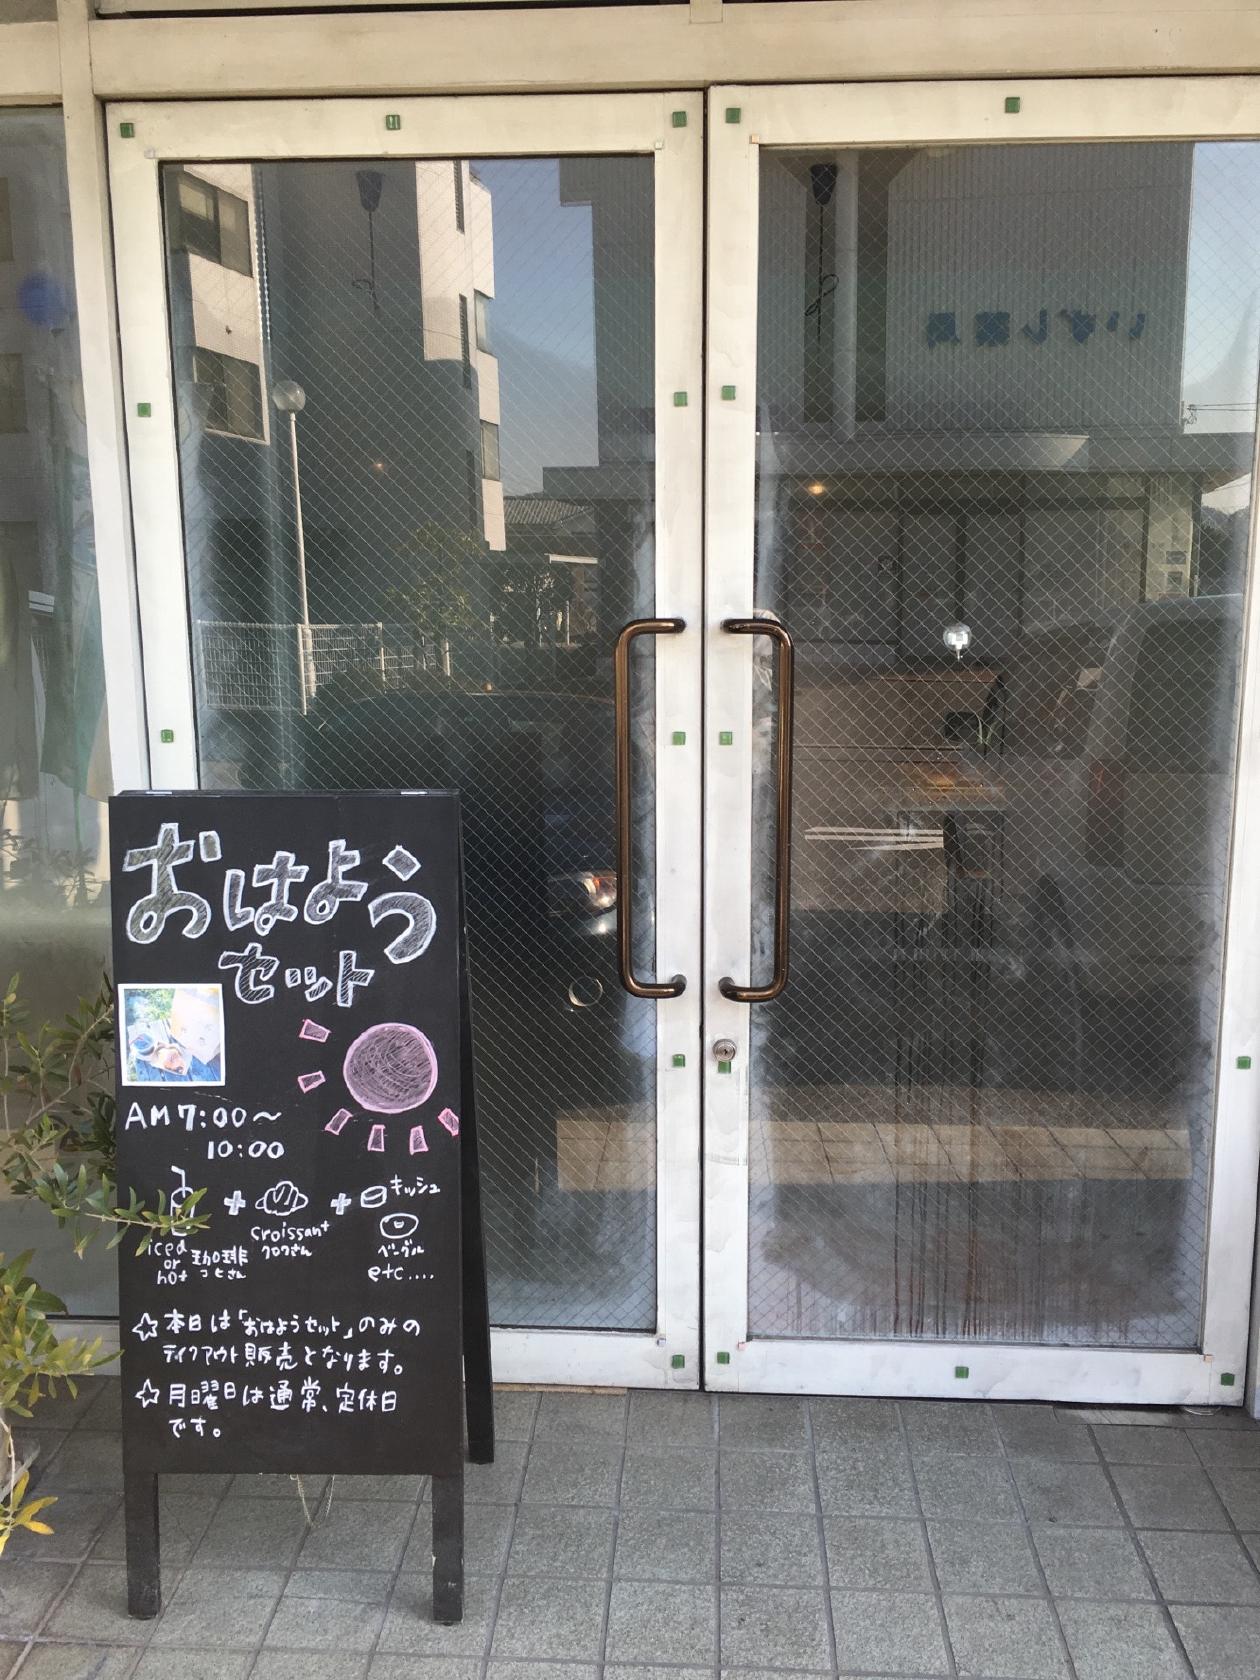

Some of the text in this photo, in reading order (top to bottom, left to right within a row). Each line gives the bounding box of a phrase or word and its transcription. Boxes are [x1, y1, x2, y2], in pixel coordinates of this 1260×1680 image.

[123, 822, 437, 965] おはよう
[218, 942, 375, 1008] セット
[125, 1102, 170, 1131] AM
[207, 1140, 285, 1160] 10:00
[390, 1173, 441, 1197] キッシュ
[148, 1239, 187, 1257] iced
[190, 1244, 249, 1267] 珈琲
[378, 1238, 425, 1258] ベーグル
[163, 1258, 181, 1270] or
[157, 1269, 188, 1285] hot
[168, 1375, 398, 1414] 月曜日は通常、定休日
[168, 1417, 222, 1438] です。
